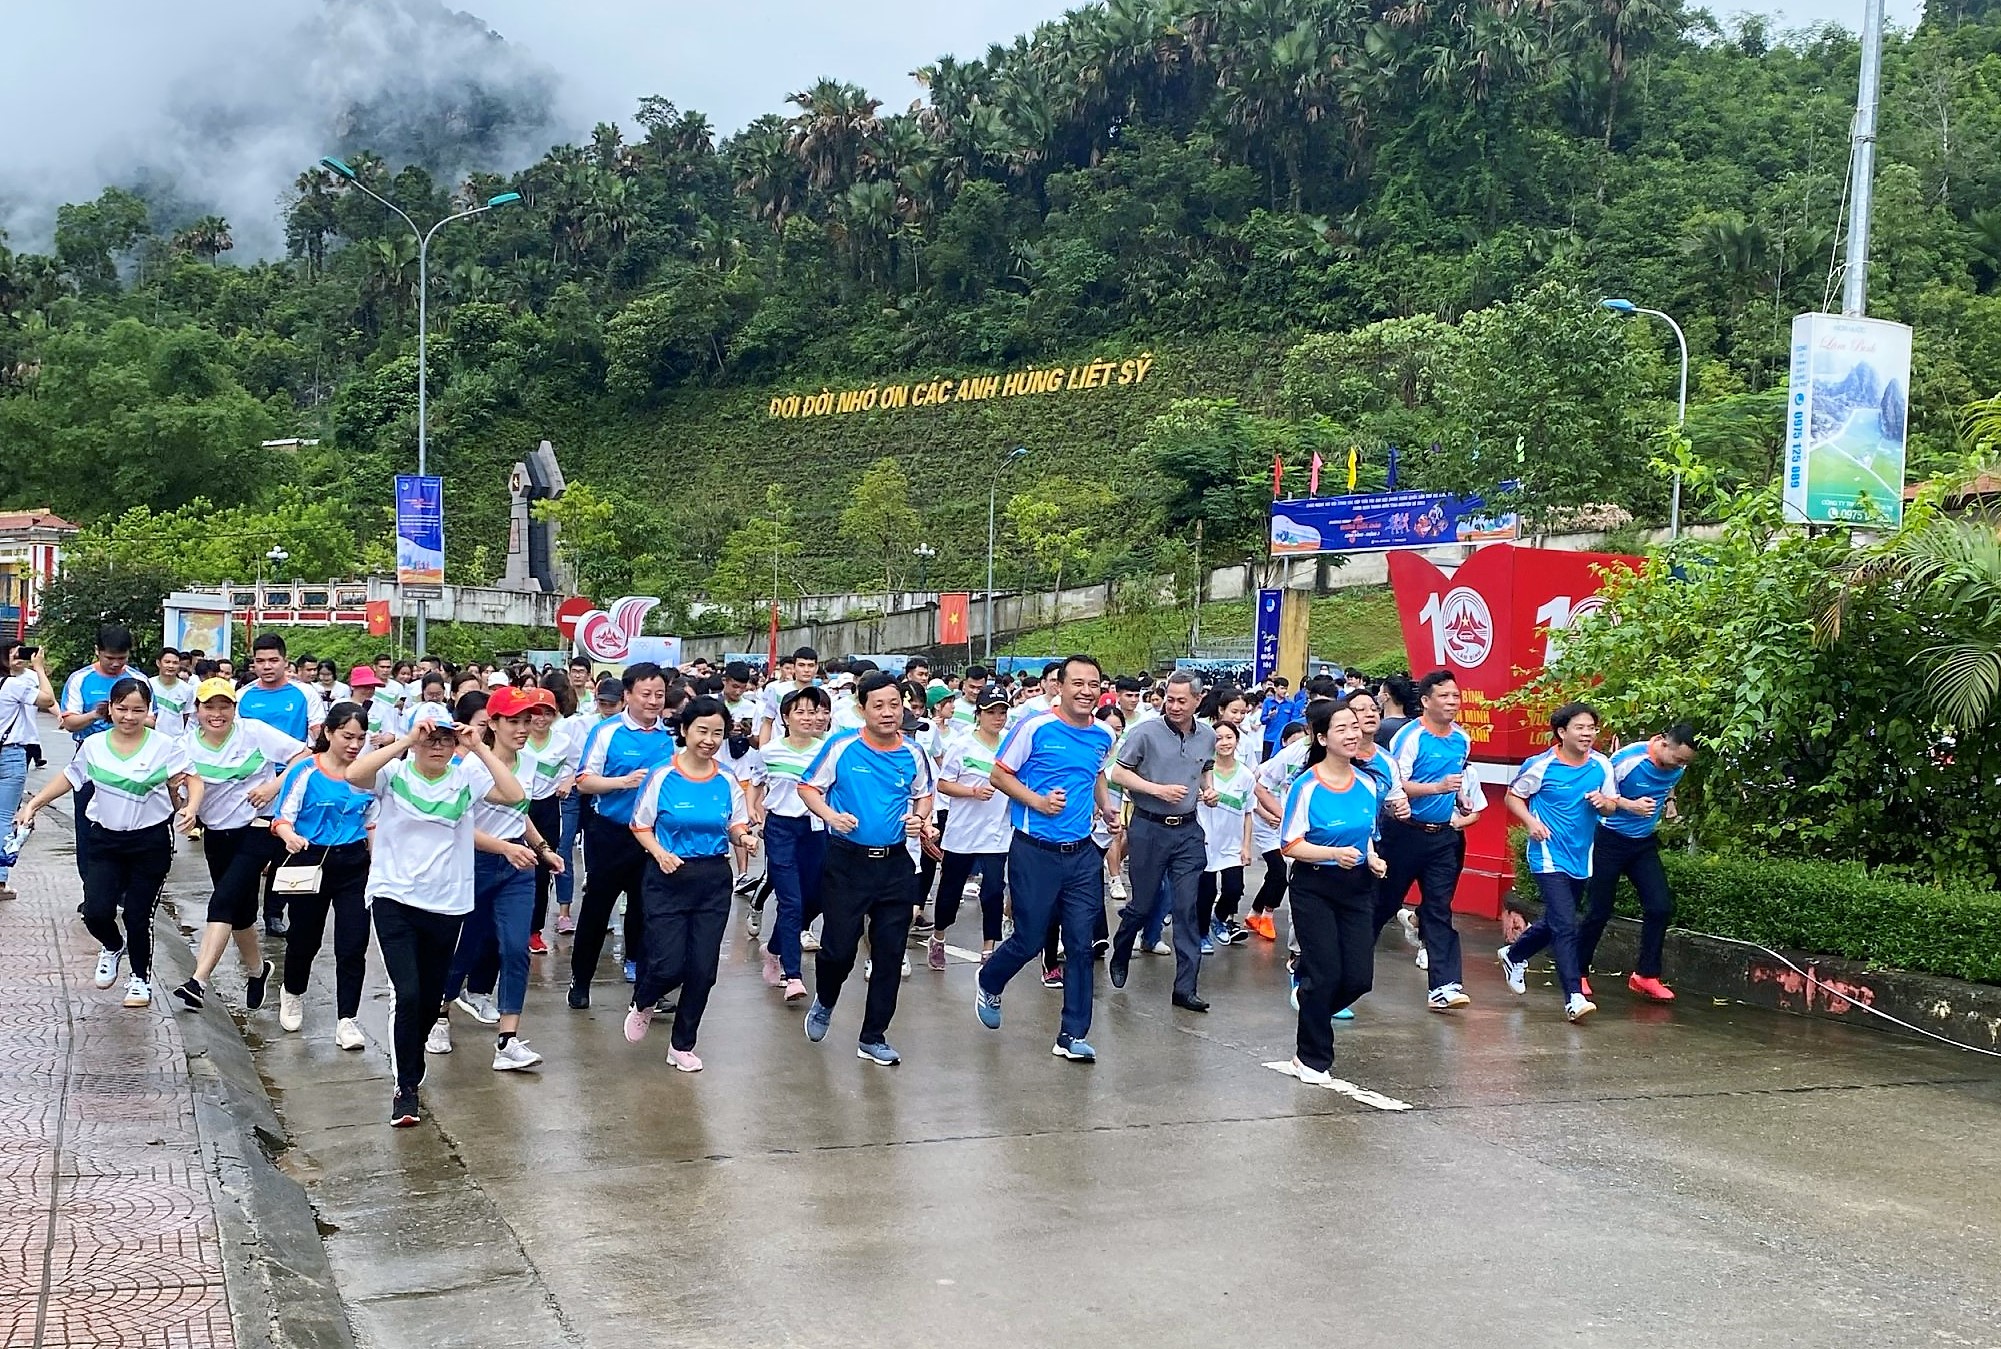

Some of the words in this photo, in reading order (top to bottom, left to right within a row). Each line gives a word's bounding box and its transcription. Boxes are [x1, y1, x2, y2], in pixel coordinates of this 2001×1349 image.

[802, 387, 835, 417] ĐỜI
[836, 383, 878, 414] NHỚ
[880, 385, 909, 409] ƠN
[912, 375, 953, 407] CÁC
[954, 375, 1000, 402] ANH
[1001, 365, 1065, 397] HÙNG
[1066, 357, 1117, 392] LIỆT
[1793, 411, 1803, 439] 0975
[1791, 443, 1801, 463] 125
